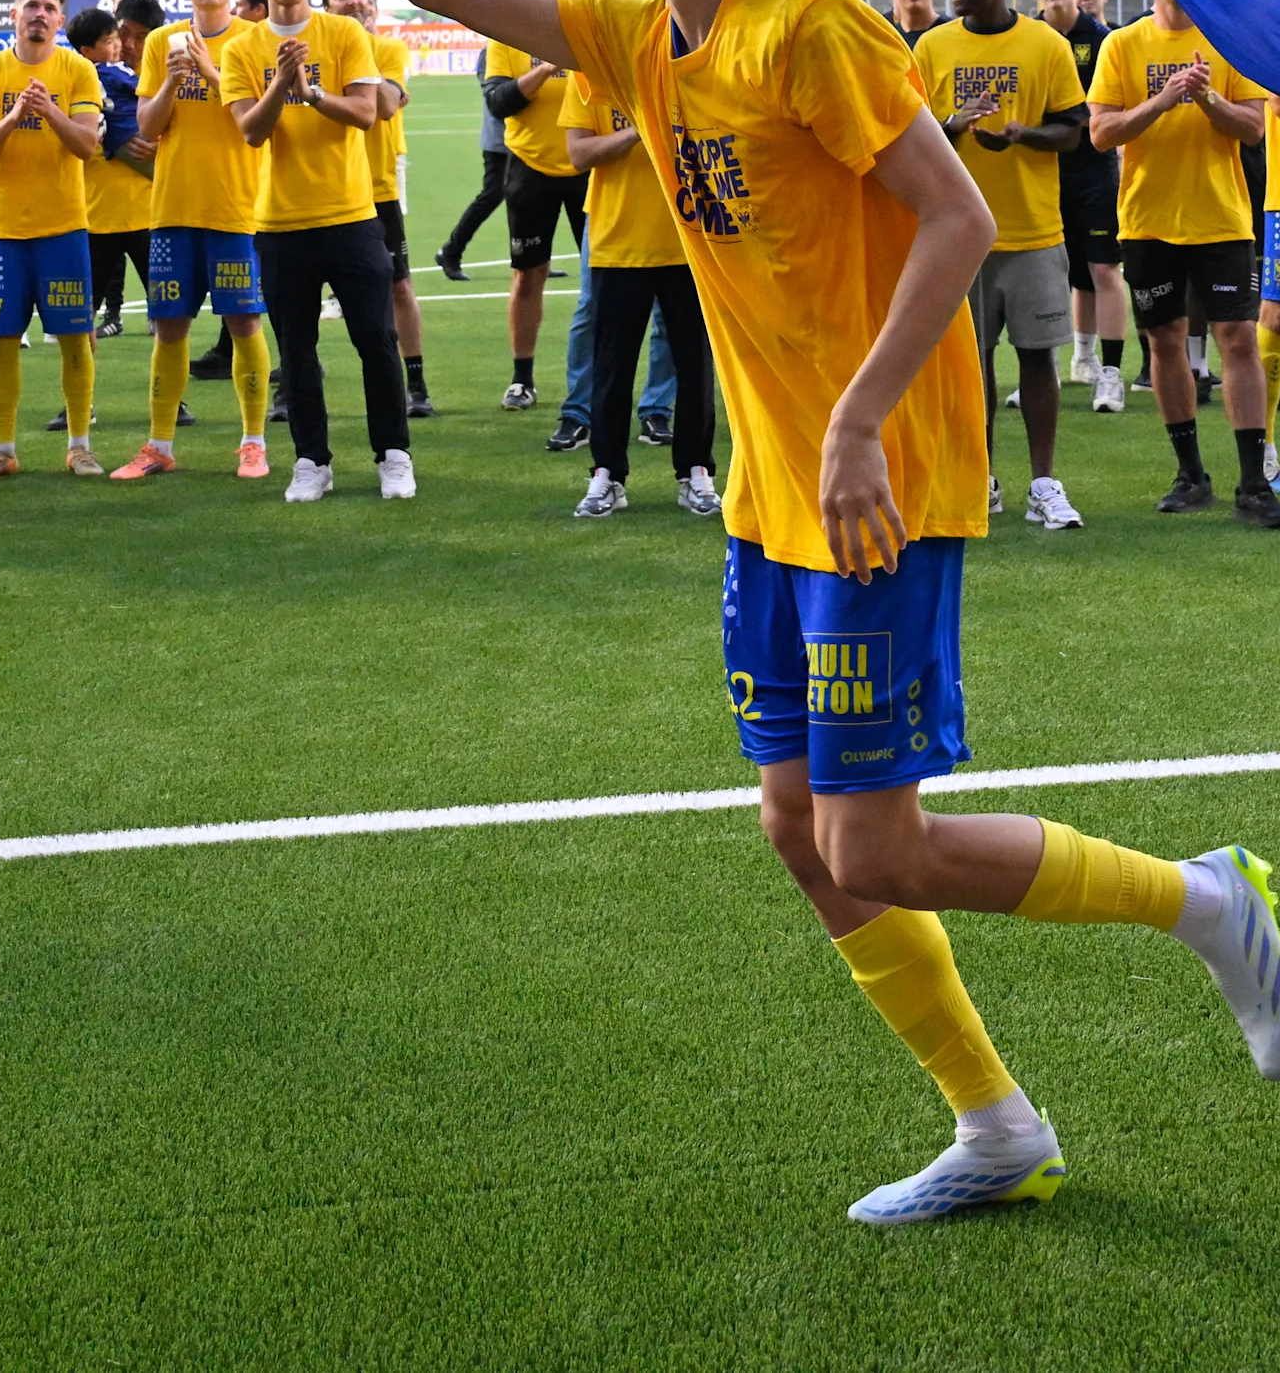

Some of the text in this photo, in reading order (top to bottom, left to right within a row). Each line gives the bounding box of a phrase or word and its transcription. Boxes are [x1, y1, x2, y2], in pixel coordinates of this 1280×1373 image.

[954, 66, 1019, 81] EUROPE
[954, 80, 1018, 94] HERE WE
[713, 168, 751, 201] WE
[216, 262, 250, 276] PAULI
[49, 281, 84, 294] PAULI
[214, 275, 252, 289] BETON
[158, 280, 181, 302] 18
[1150, 281, 1175, 299] SDR
[47, 293, 85, 306] BETON
[806, 680, 874, 715] ETON
[841, 747, 896, 765] OLYMPIC
